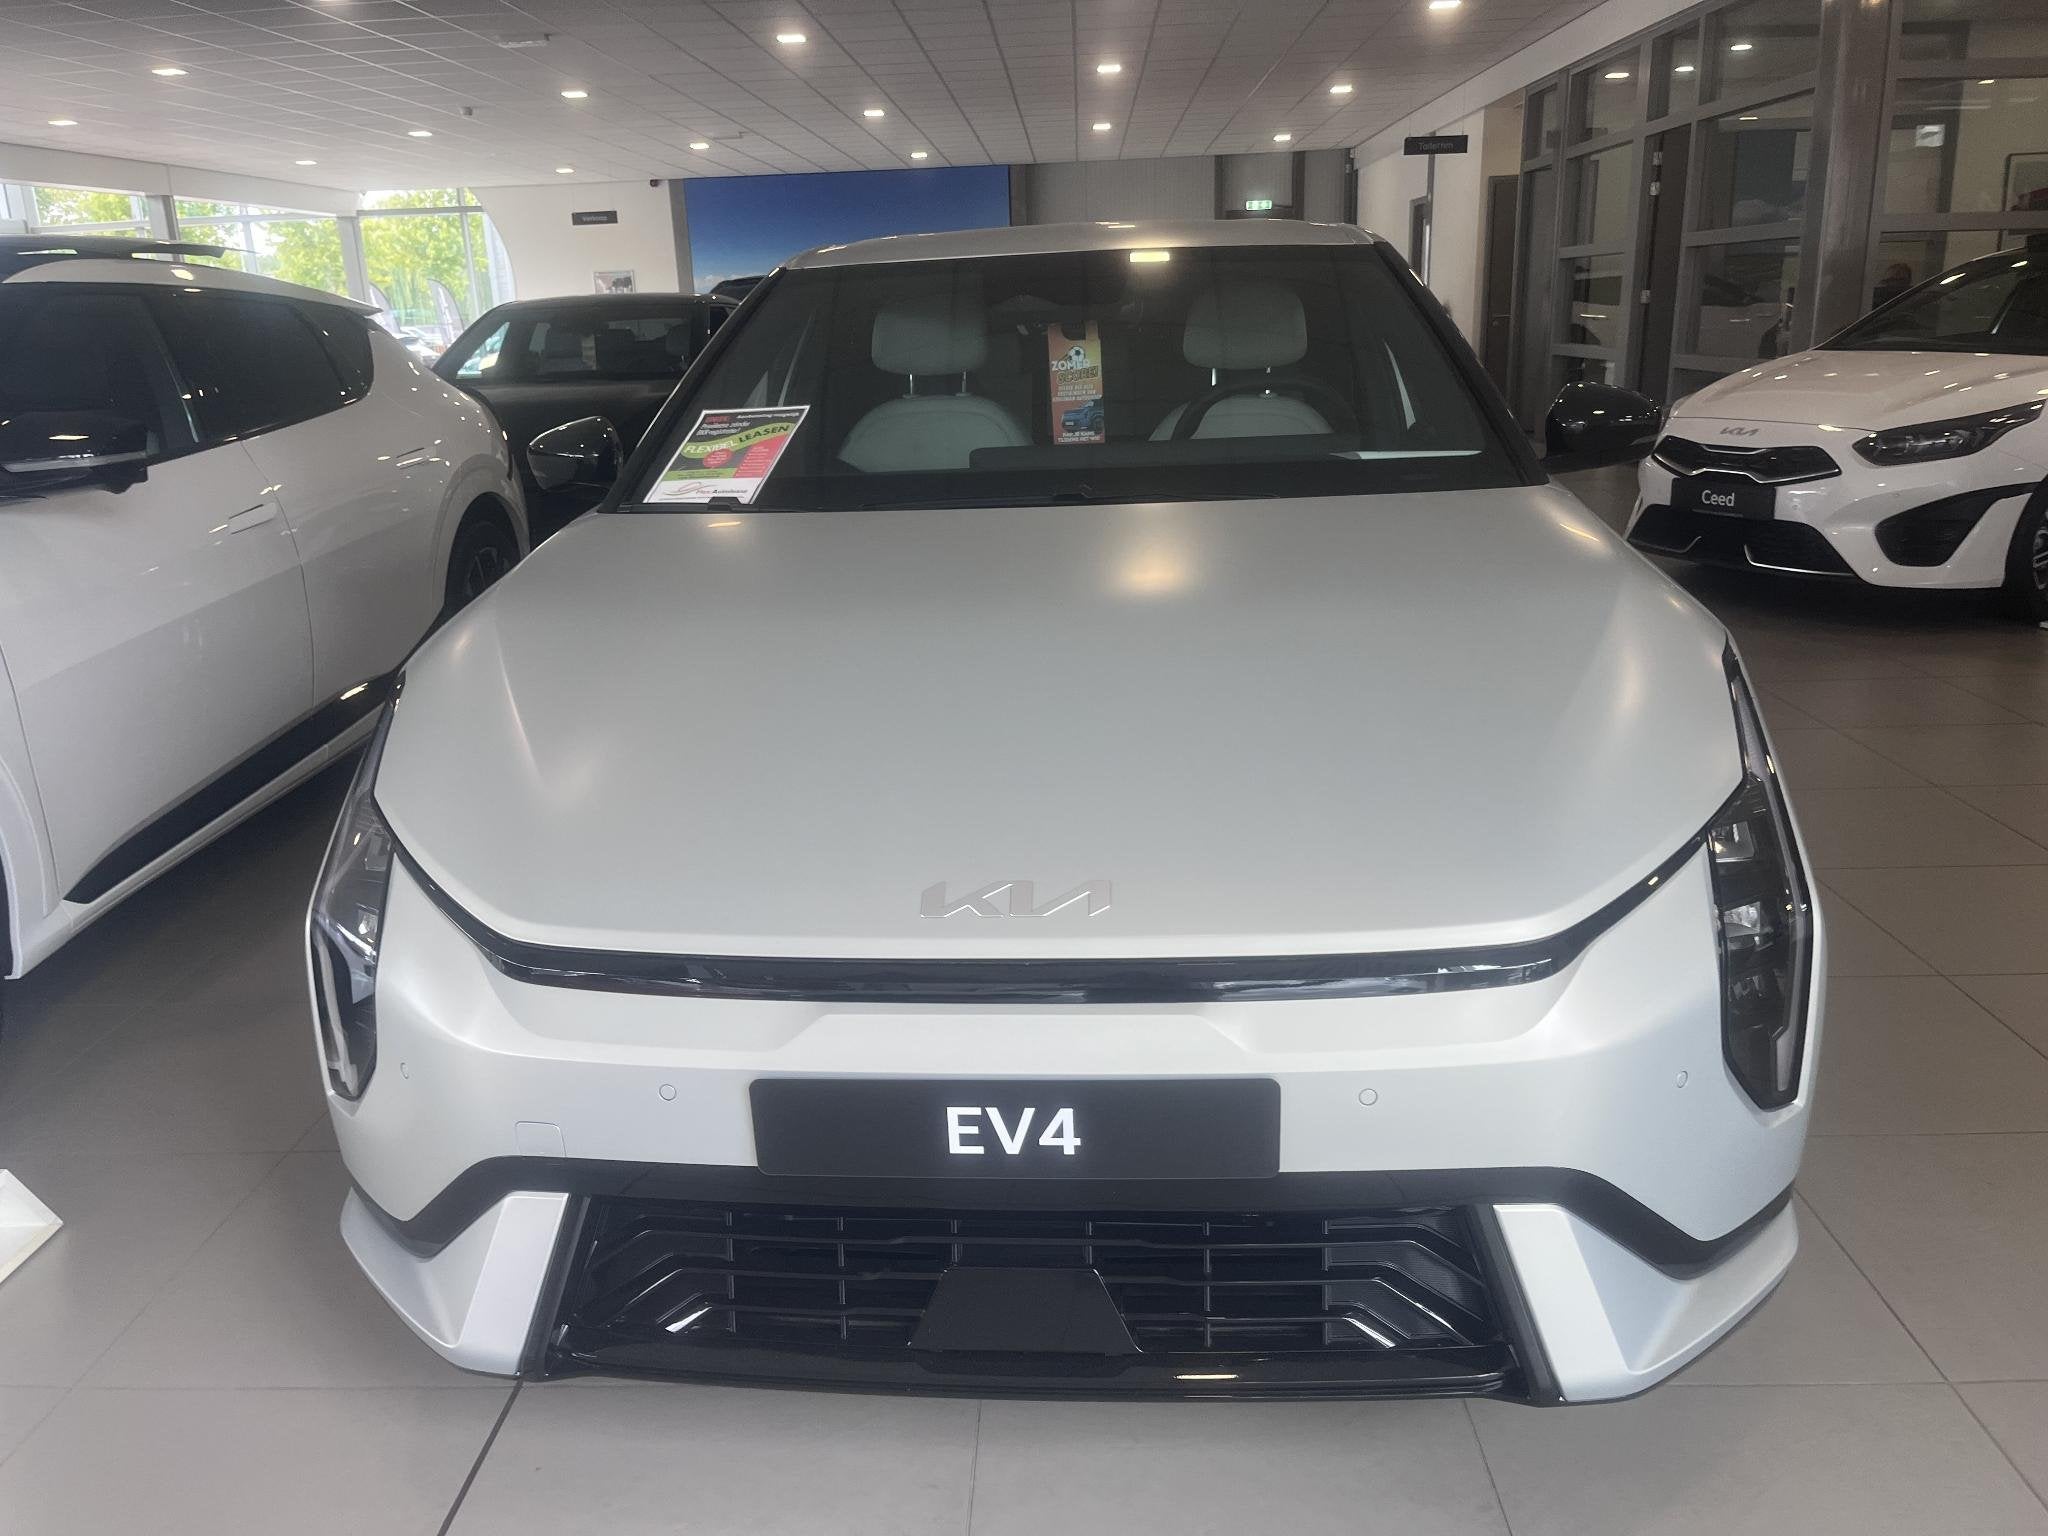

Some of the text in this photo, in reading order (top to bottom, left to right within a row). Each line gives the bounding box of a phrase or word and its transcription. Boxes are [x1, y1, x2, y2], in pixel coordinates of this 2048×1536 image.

[1051, 360, 1090, 371] ZOMER
[738, 425, 790, 443] LEASEN
[1701, 490, 1735, 507] Ceed
[919, 879, 1113, 918] KIA
[946, 1106, 1082, 1156] EV4
